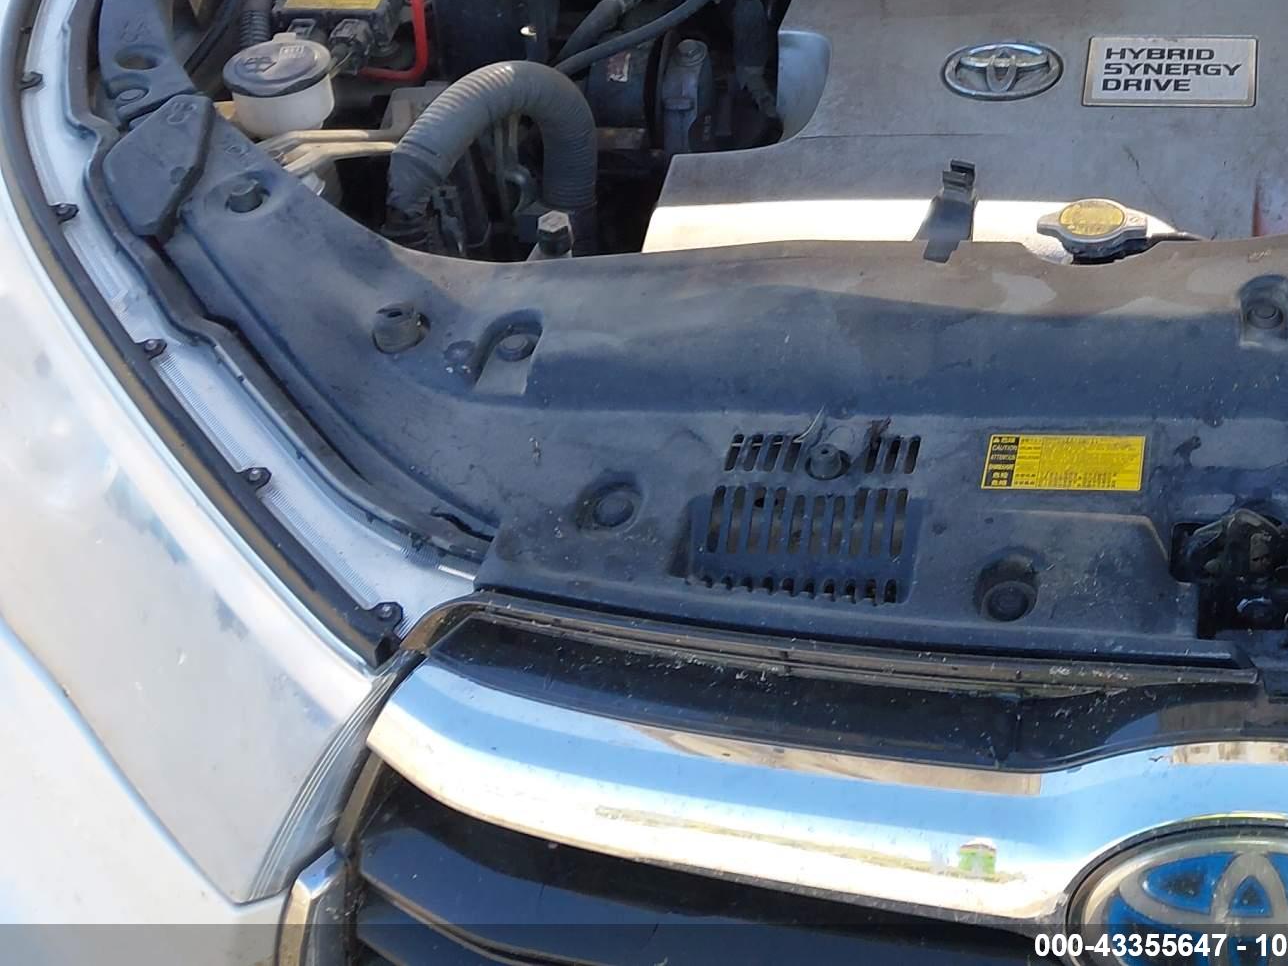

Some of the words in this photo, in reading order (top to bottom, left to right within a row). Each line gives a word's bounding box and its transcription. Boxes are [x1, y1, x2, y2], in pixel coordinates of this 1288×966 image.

[1105, 47, 1215, 61] HYBRID
[1103, 62, 1242, 76] SYNERGY
[1101, 78, 1191, 92] DRIVE
